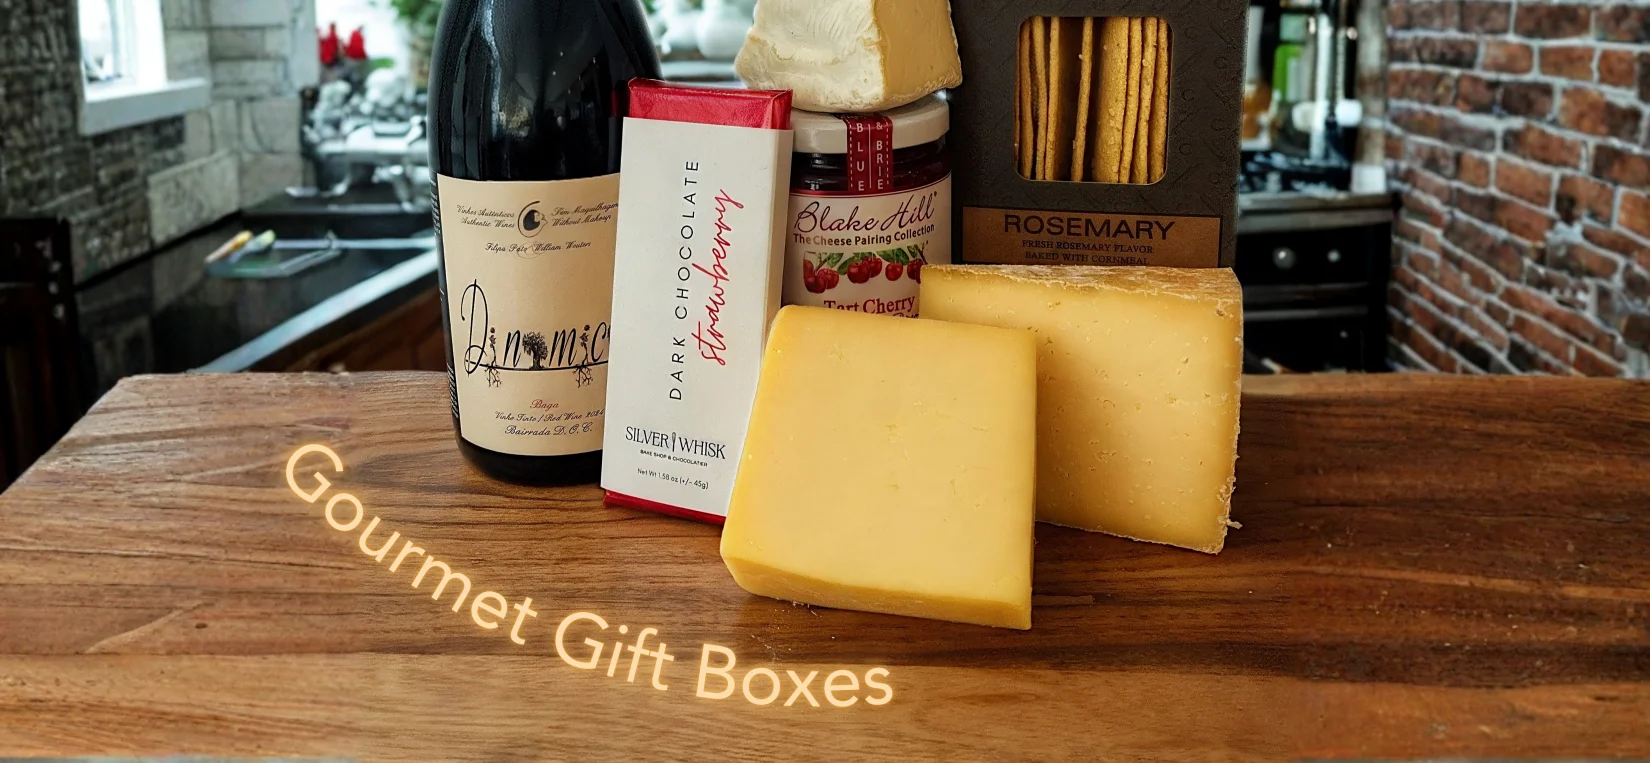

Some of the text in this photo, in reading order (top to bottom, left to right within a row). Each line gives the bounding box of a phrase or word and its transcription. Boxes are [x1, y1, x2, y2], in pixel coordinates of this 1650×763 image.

[856, 123, 865, 191] BLUE
[876, 122, 884, 190] & BRIE
[794, 192, 936, 233] Blake Hill
[493, 219, 515, 228] Wines
[552, 217, 581, 227] Without
[1004, 214, 1176, 240] ROSEMARY
[793, 224, 935, 246] The Cheese Pairing Collection
[534, 242, 561, 252] William
[1022, 240, 1154, 254] FRESH ROSEMARY FLAVOR
[1025, 251, 1150, 266] BAKED WITH CORNMEAL
[669, 161, 699, 401] DARK CHOCOLATE
[691, 189, 744, 366] strawberry
[862, 296, 915, 314] Cherry
[530, 399, 559, 412] Baga
[543, 413, 563, 422] Red
[563, 412, 583, 421] Wine
[504, 425, 551, 436] Bairrada
[625, 426, 726, 460] SILVER WHISK
[640, 449, 653, 457] BAKE
[672, 456, 708, 467] CHOCOLATIER
[637, 467, 648, 476] Net
[648, 469, 657, 478] Wt
